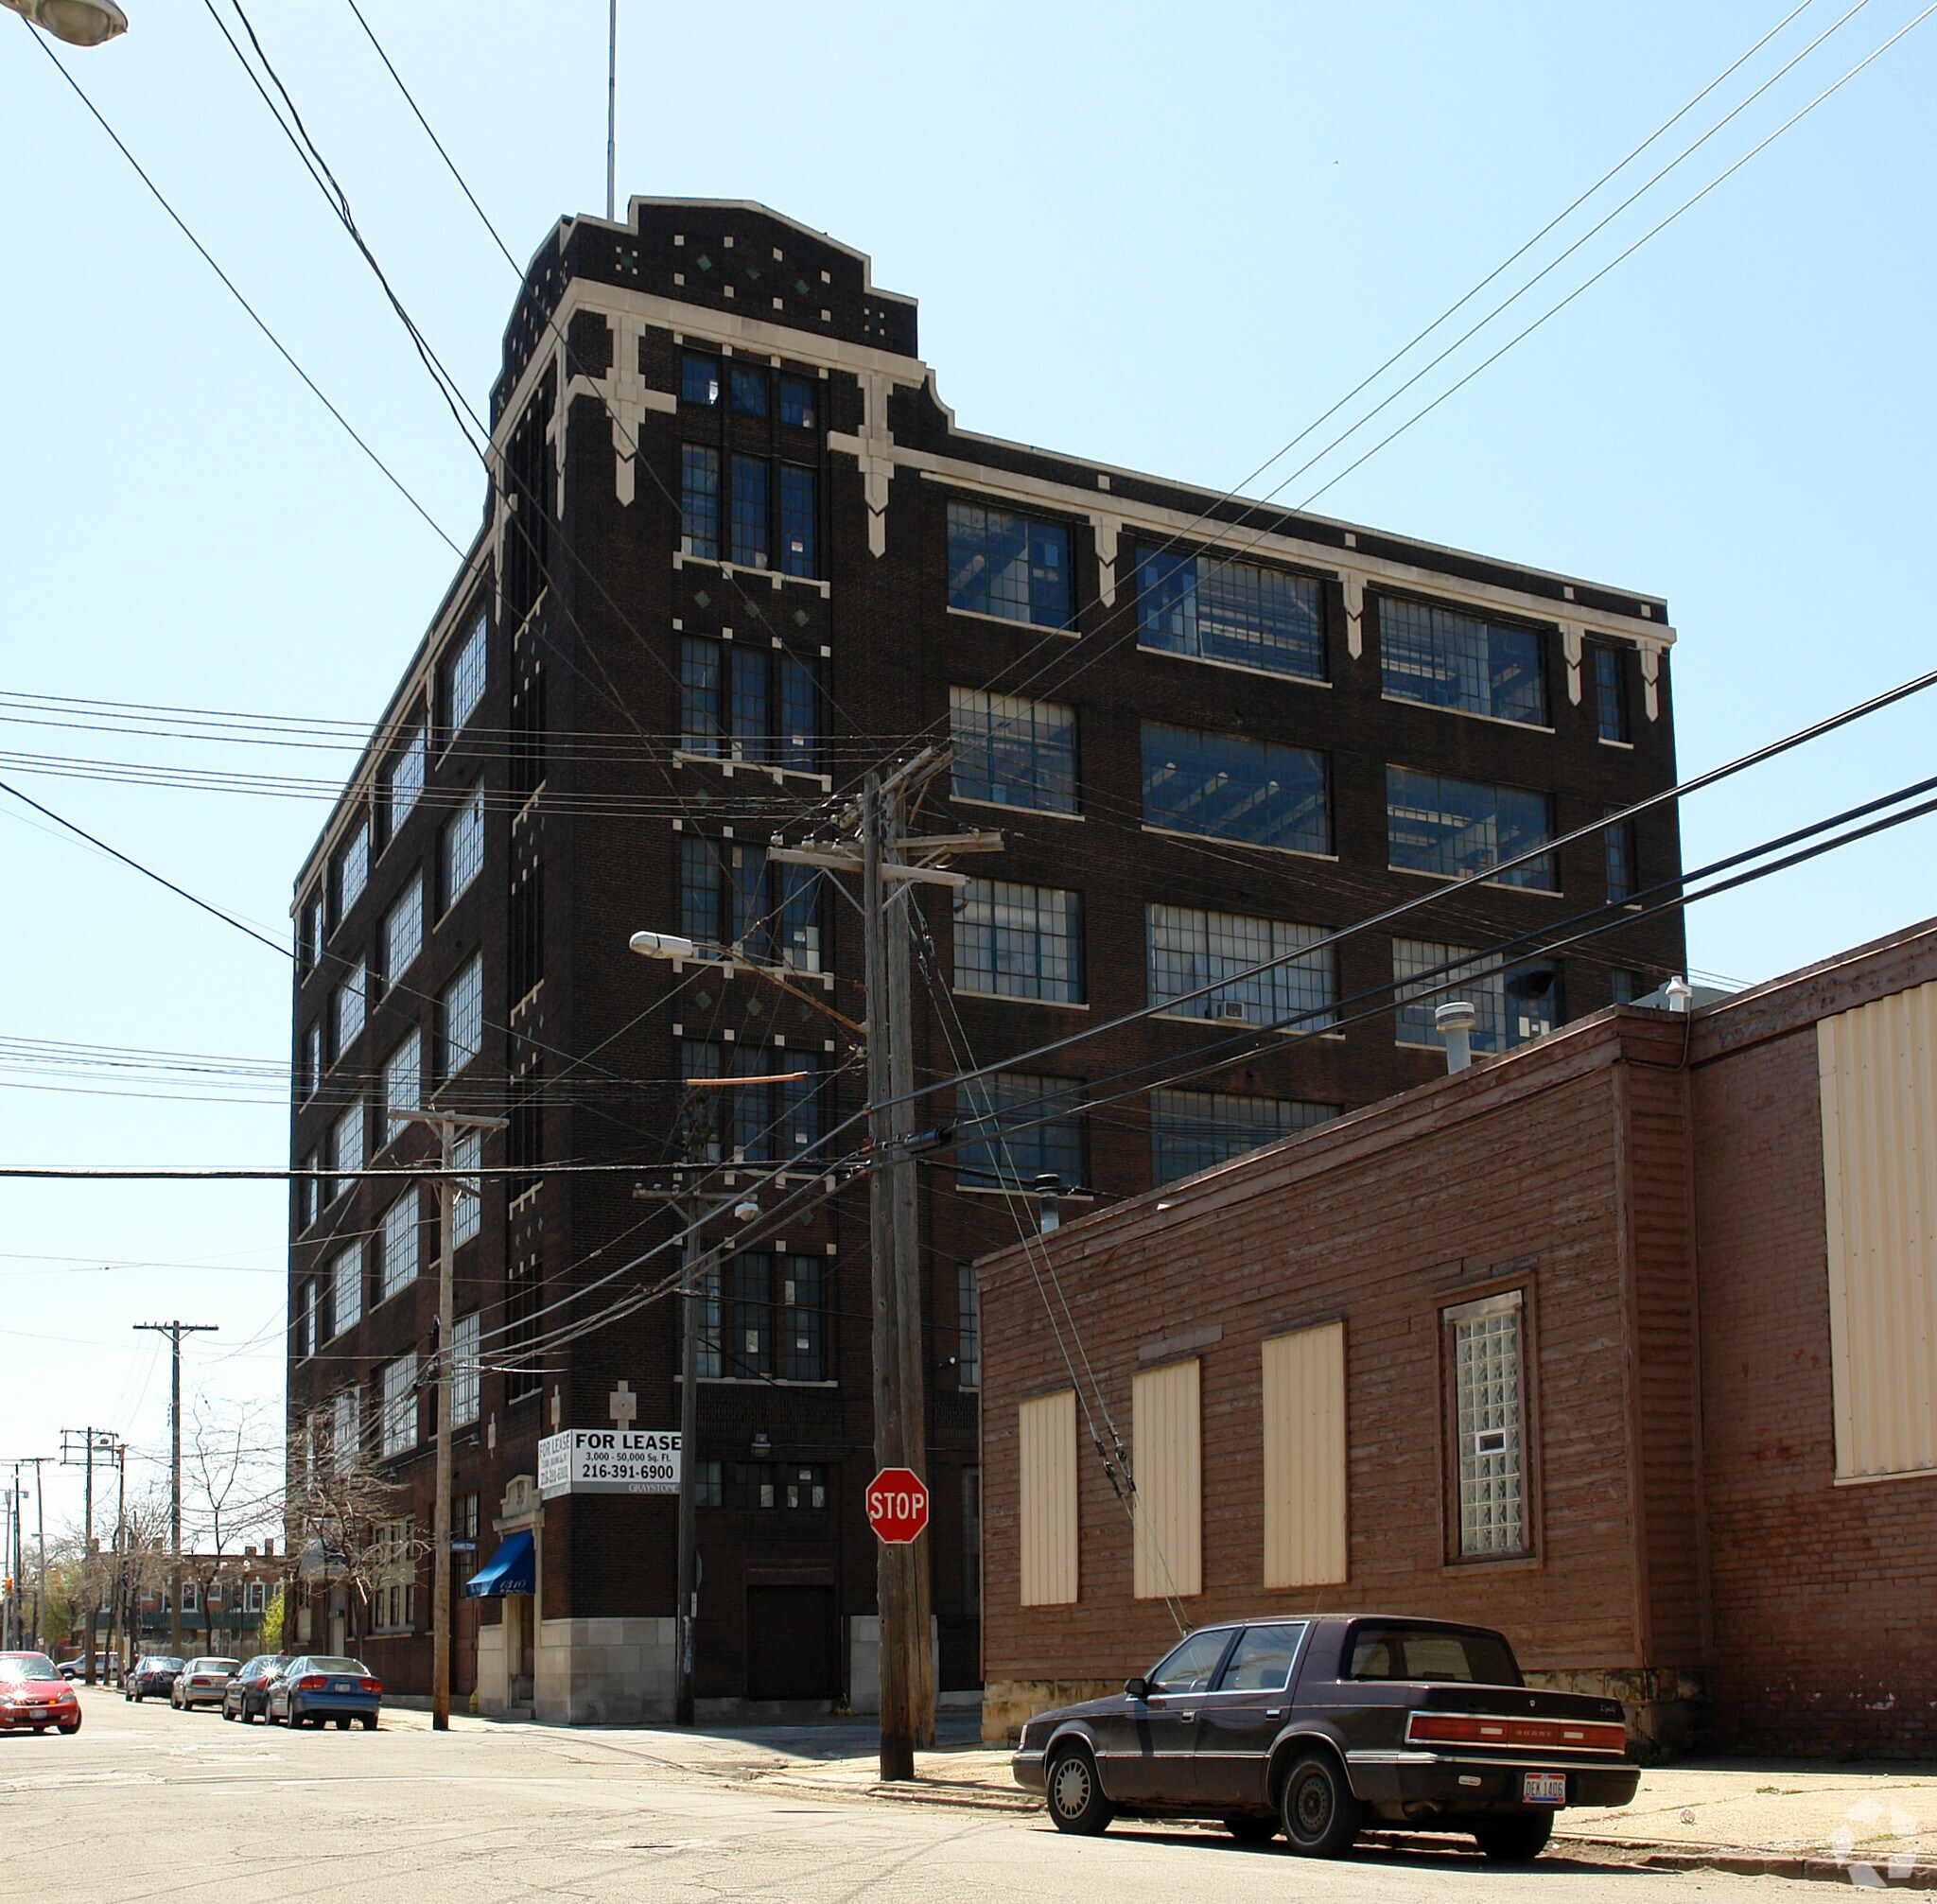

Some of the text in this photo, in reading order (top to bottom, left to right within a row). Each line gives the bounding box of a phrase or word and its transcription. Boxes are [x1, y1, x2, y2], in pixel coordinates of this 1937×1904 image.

[576, 1433, 682, 1451] FOR LEASE
[585, 1452, 609, 1462] 3,000
[616, 1453, 645, 1462] 50,000
[647, 1453, 659, 1463] Sq.
[661, 1453, 672, 1462] Ft.
[582, 1463, 674, 1479] 216-391-6900
[628, 1483, 679, 1493] GRAYSTONE
[870, 1492, 925, 1520] STOP
